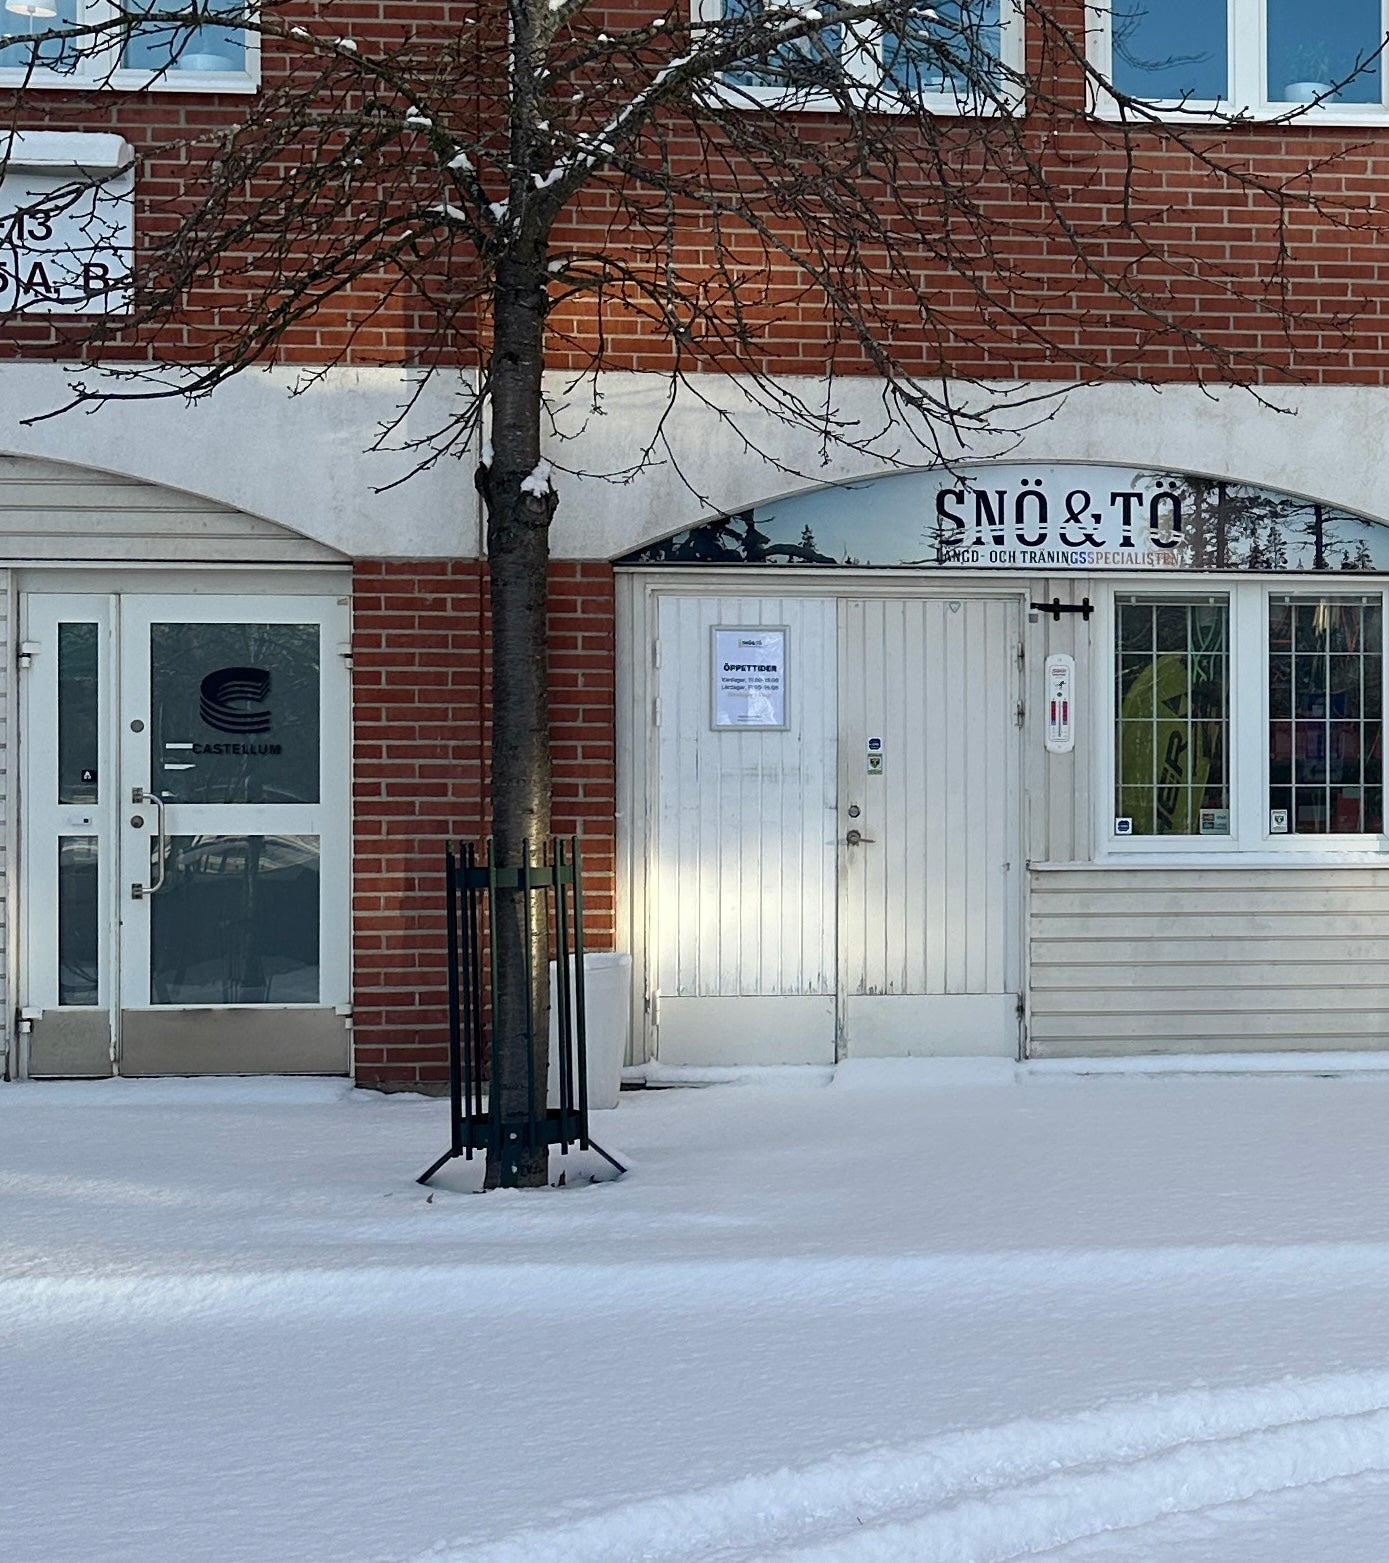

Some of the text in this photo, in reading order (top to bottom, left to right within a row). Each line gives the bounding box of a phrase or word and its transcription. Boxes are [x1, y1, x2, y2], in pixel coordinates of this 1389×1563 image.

[82, 262, 110, 295] B
[989, 549, 1017, 564] OCH
[723, 662, 777, 672] ÖPPETTIDER
[192, 743, 283, 755] CASTELLUM
